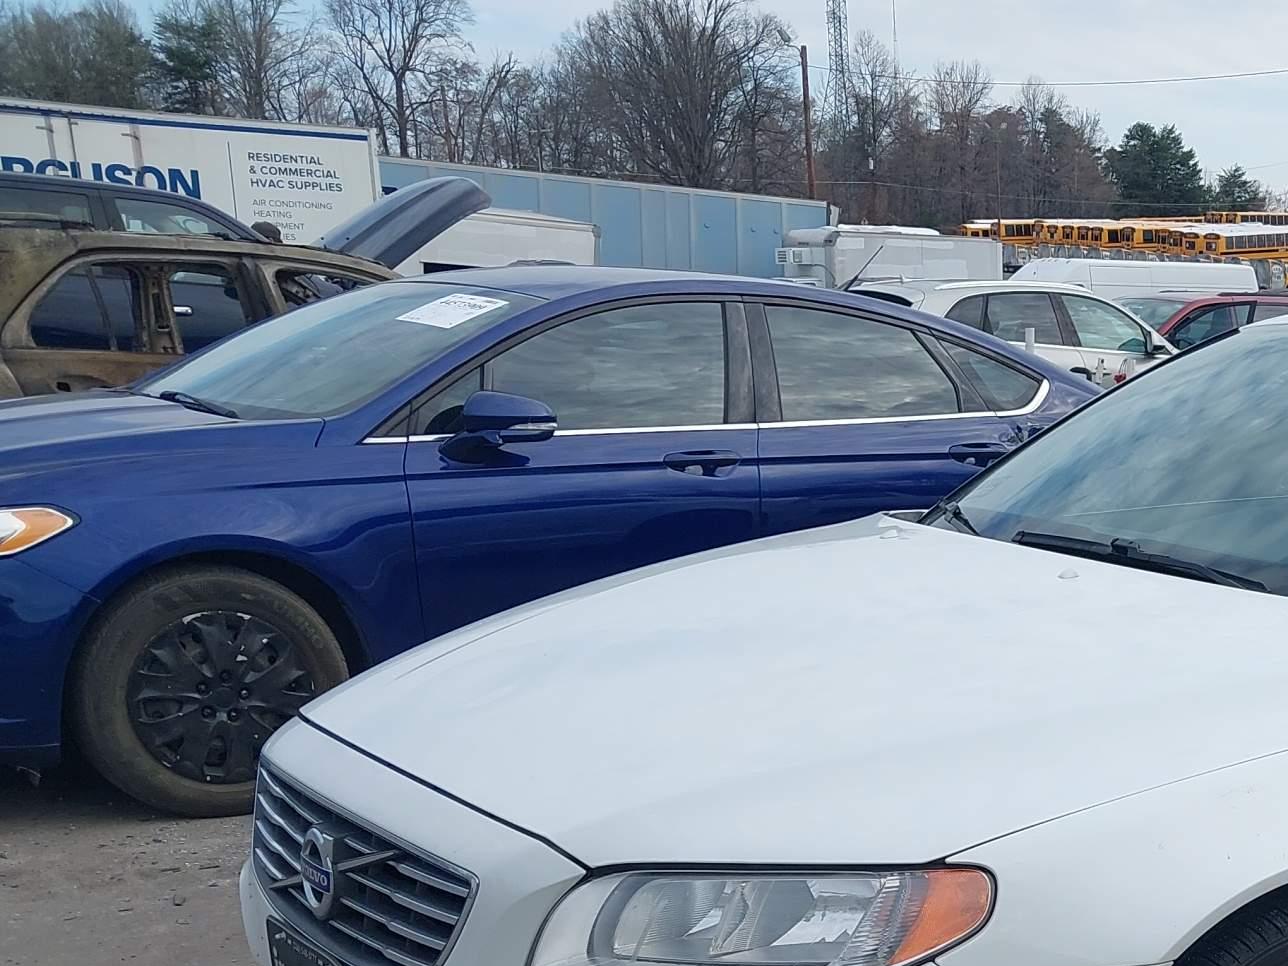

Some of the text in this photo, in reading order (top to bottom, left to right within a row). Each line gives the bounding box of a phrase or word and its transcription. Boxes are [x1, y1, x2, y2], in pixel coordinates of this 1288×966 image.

[248, 152, 324, 166] RESIDENTIAL
[249, 165, 340, 180] & COMMERCIAL
[250, 178, 343, 193] HVAC SUPPLIES
[252, 199, 333, 210] AIR CONDITIONING
[253, 210, 293, 219] HEATING
